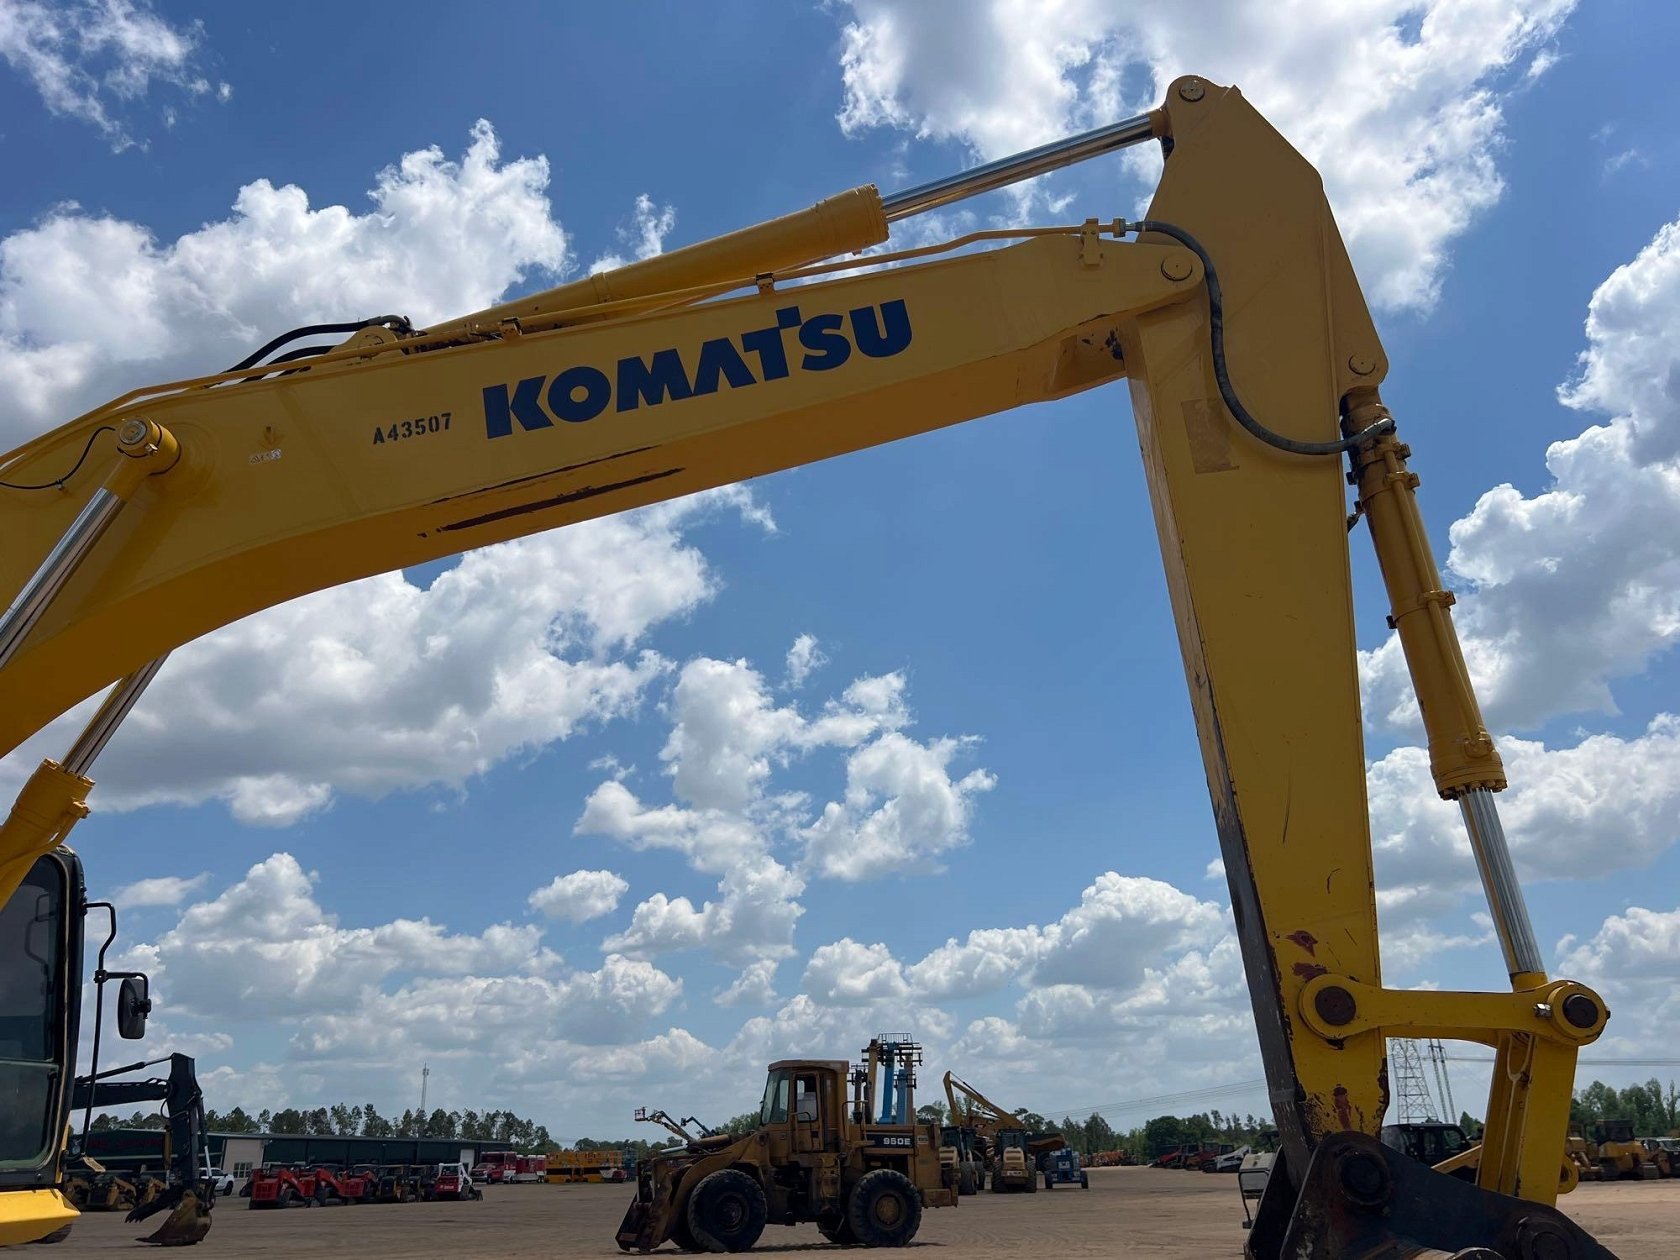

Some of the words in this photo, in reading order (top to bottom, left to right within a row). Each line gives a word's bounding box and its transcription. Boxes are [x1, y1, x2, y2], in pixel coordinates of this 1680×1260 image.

[482, 298, 913, 440] KOMATSU
[373, 412, 451, 445] A43507
[883, 1137, 911, 1145] 950E
